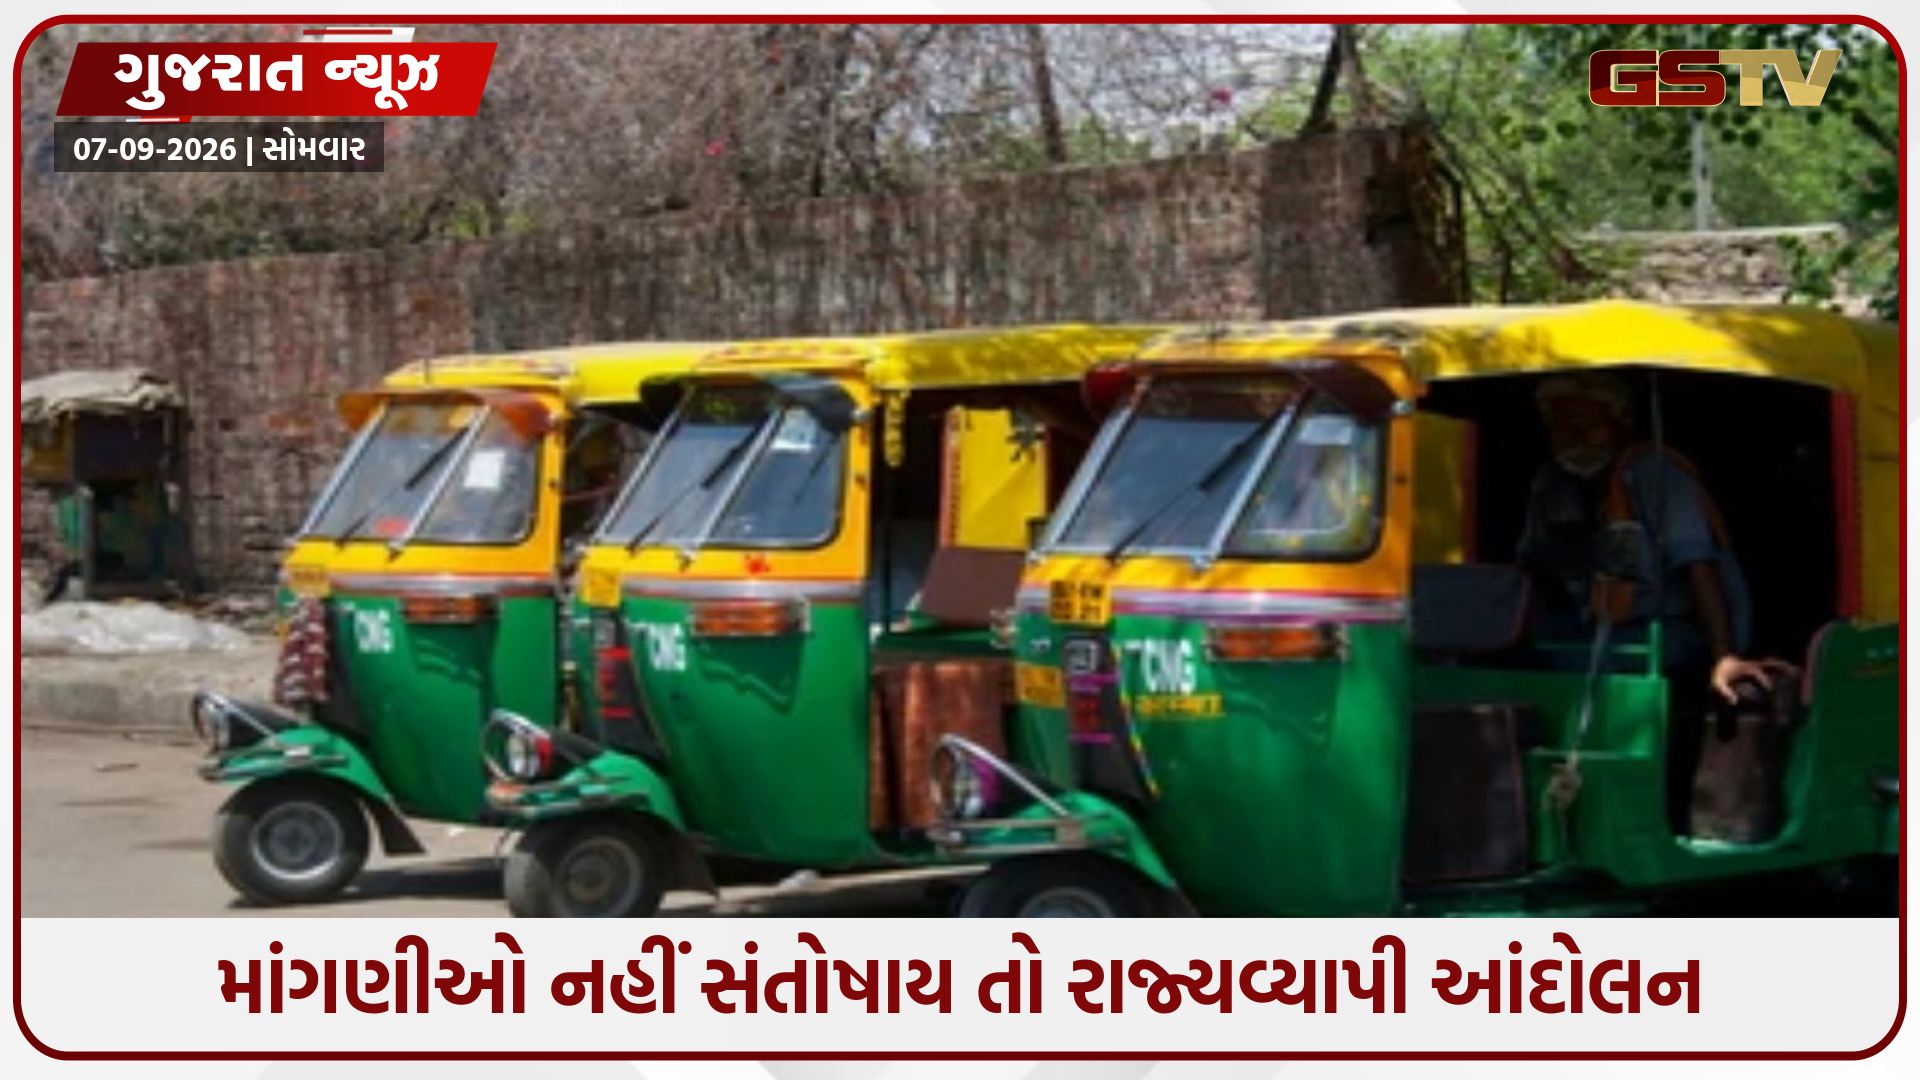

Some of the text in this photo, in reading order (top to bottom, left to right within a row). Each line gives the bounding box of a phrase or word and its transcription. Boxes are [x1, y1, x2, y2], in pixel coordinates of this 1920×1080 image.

[354, 609, 394, 654] CNG
[648, 622, 687, 672] CNG
[1141, 638, 1197, 695] CNG
